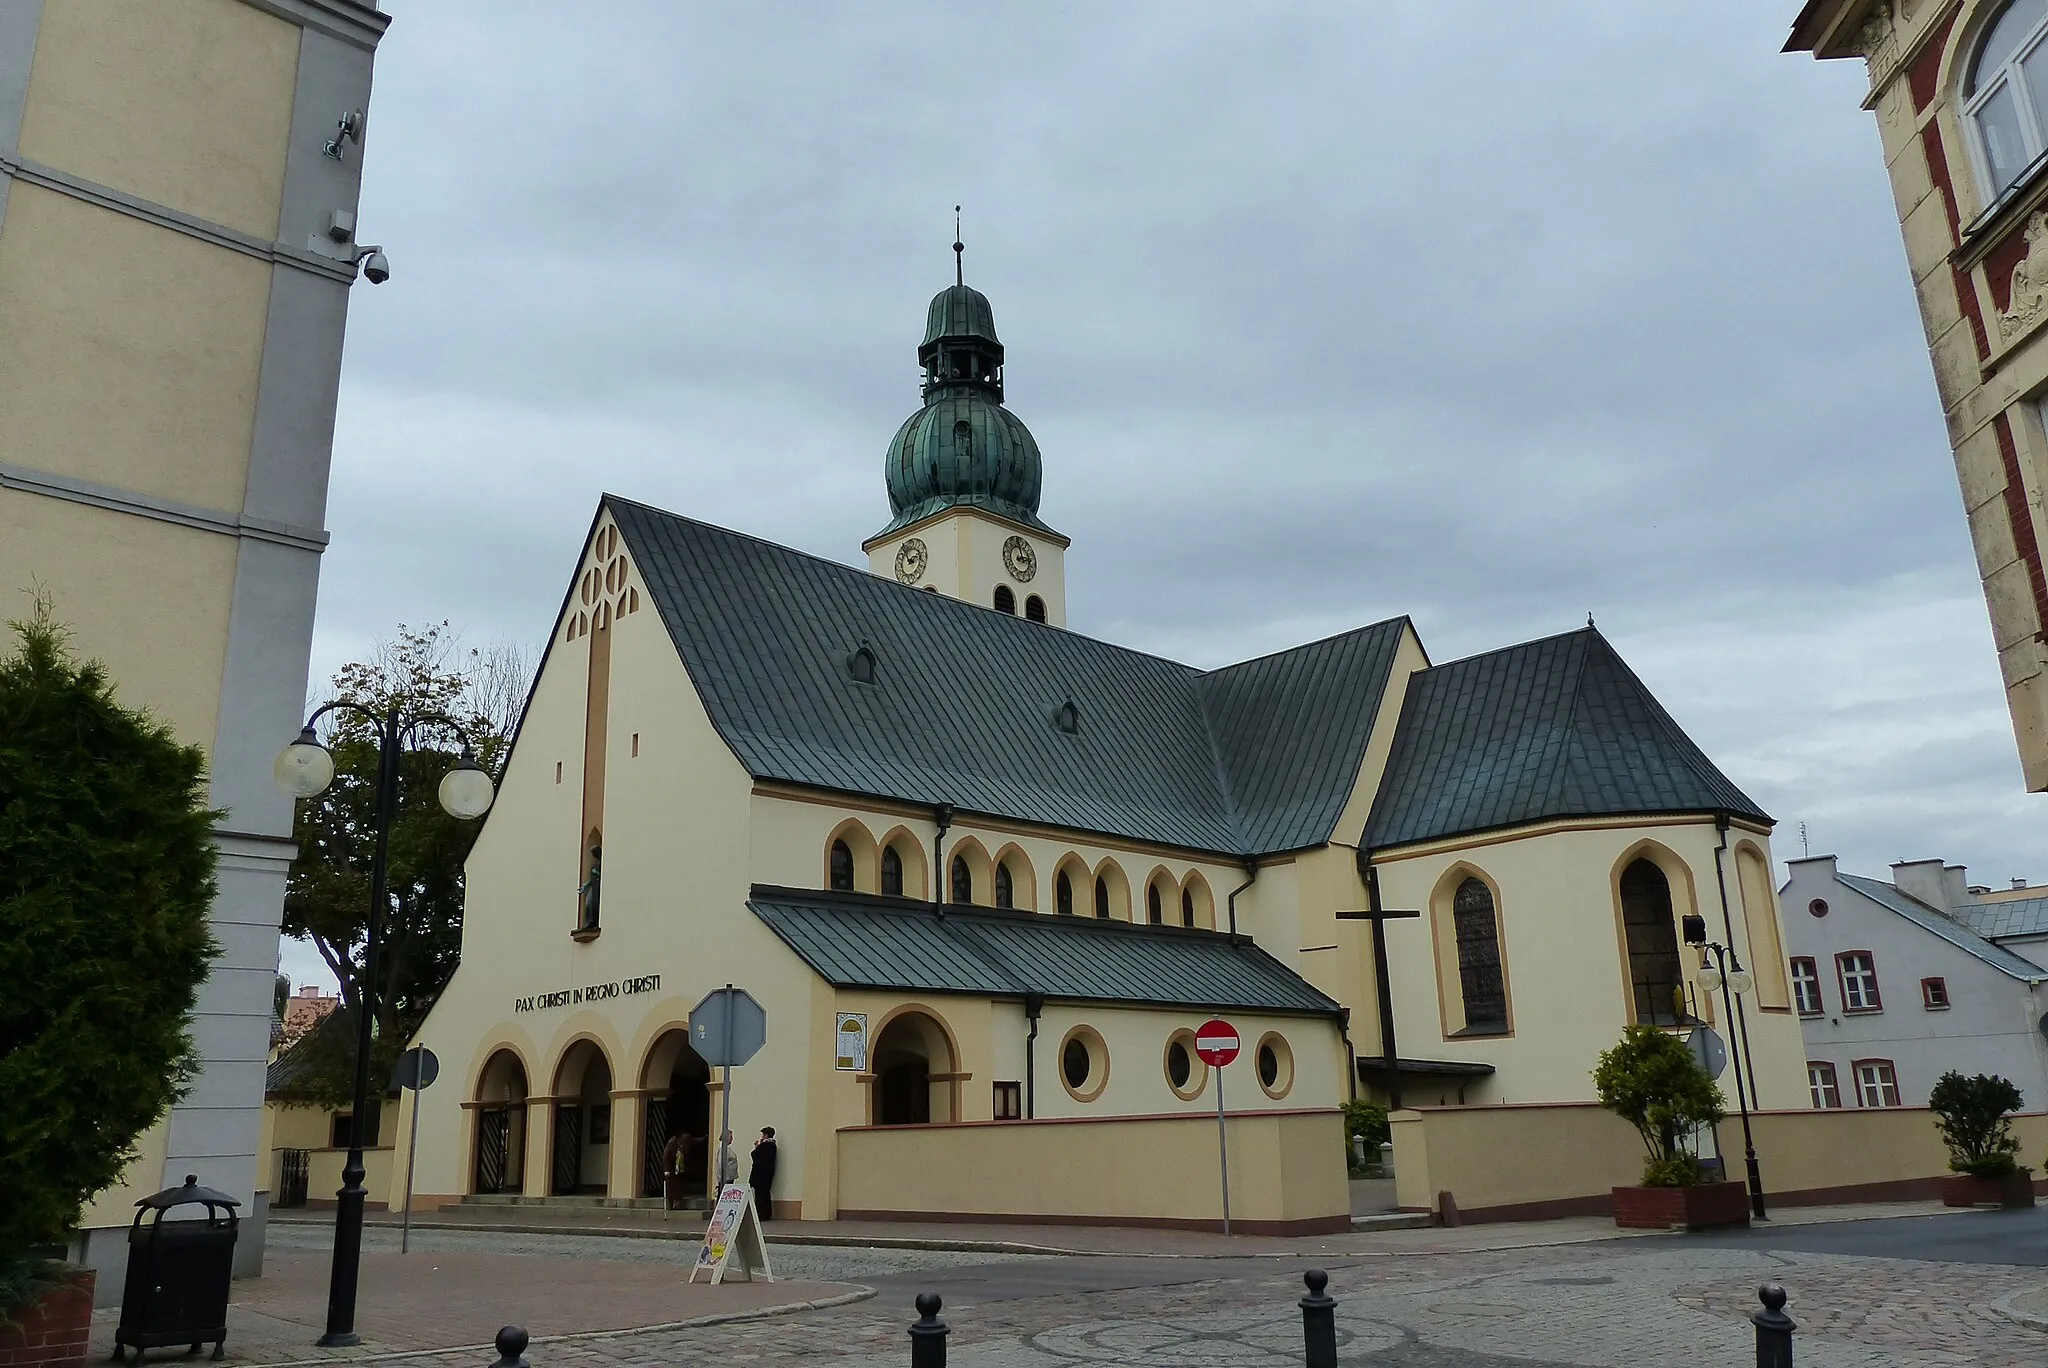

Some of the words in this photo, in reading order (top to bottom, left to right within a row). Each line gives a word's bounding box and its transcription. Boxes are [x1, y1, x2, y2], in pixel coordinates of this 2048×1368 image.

[515, 996, 534, 1012] PAX
[537, 991, 570, 1009] CHRISTI
[573, 988, 583, 1004] IN
[586, 982, 619, 1001] REGNO
[622, 974, 661, 994] CHRISTI
